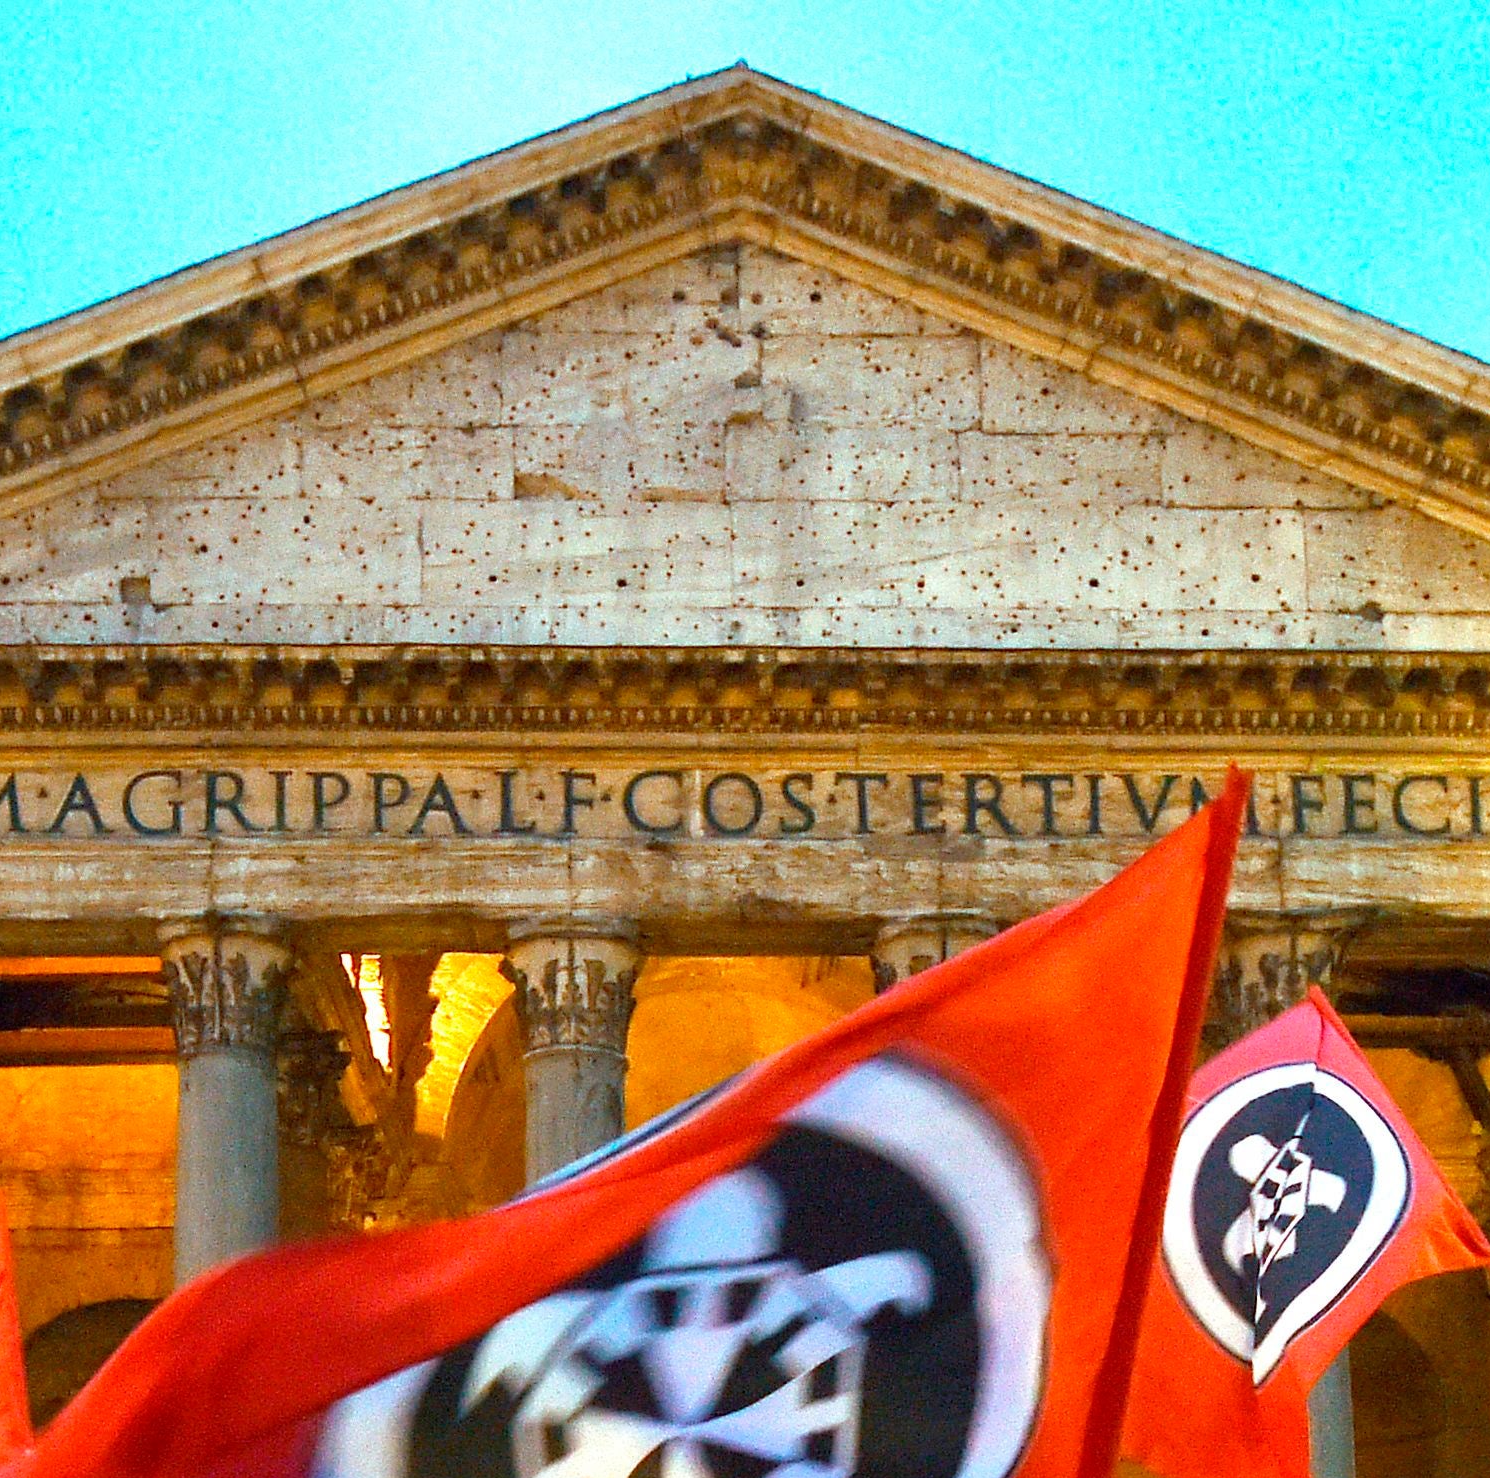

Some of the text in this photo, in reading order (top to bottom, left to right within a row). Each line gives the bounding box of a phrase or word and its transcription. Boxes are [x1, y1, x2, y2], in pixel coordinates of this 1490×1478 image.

[47, 770, 475, 836] AGRIPPA
[492, 768, 537, 835] L
[557, 768, 597, 835] F
[622, 769, 816, 836] COS
